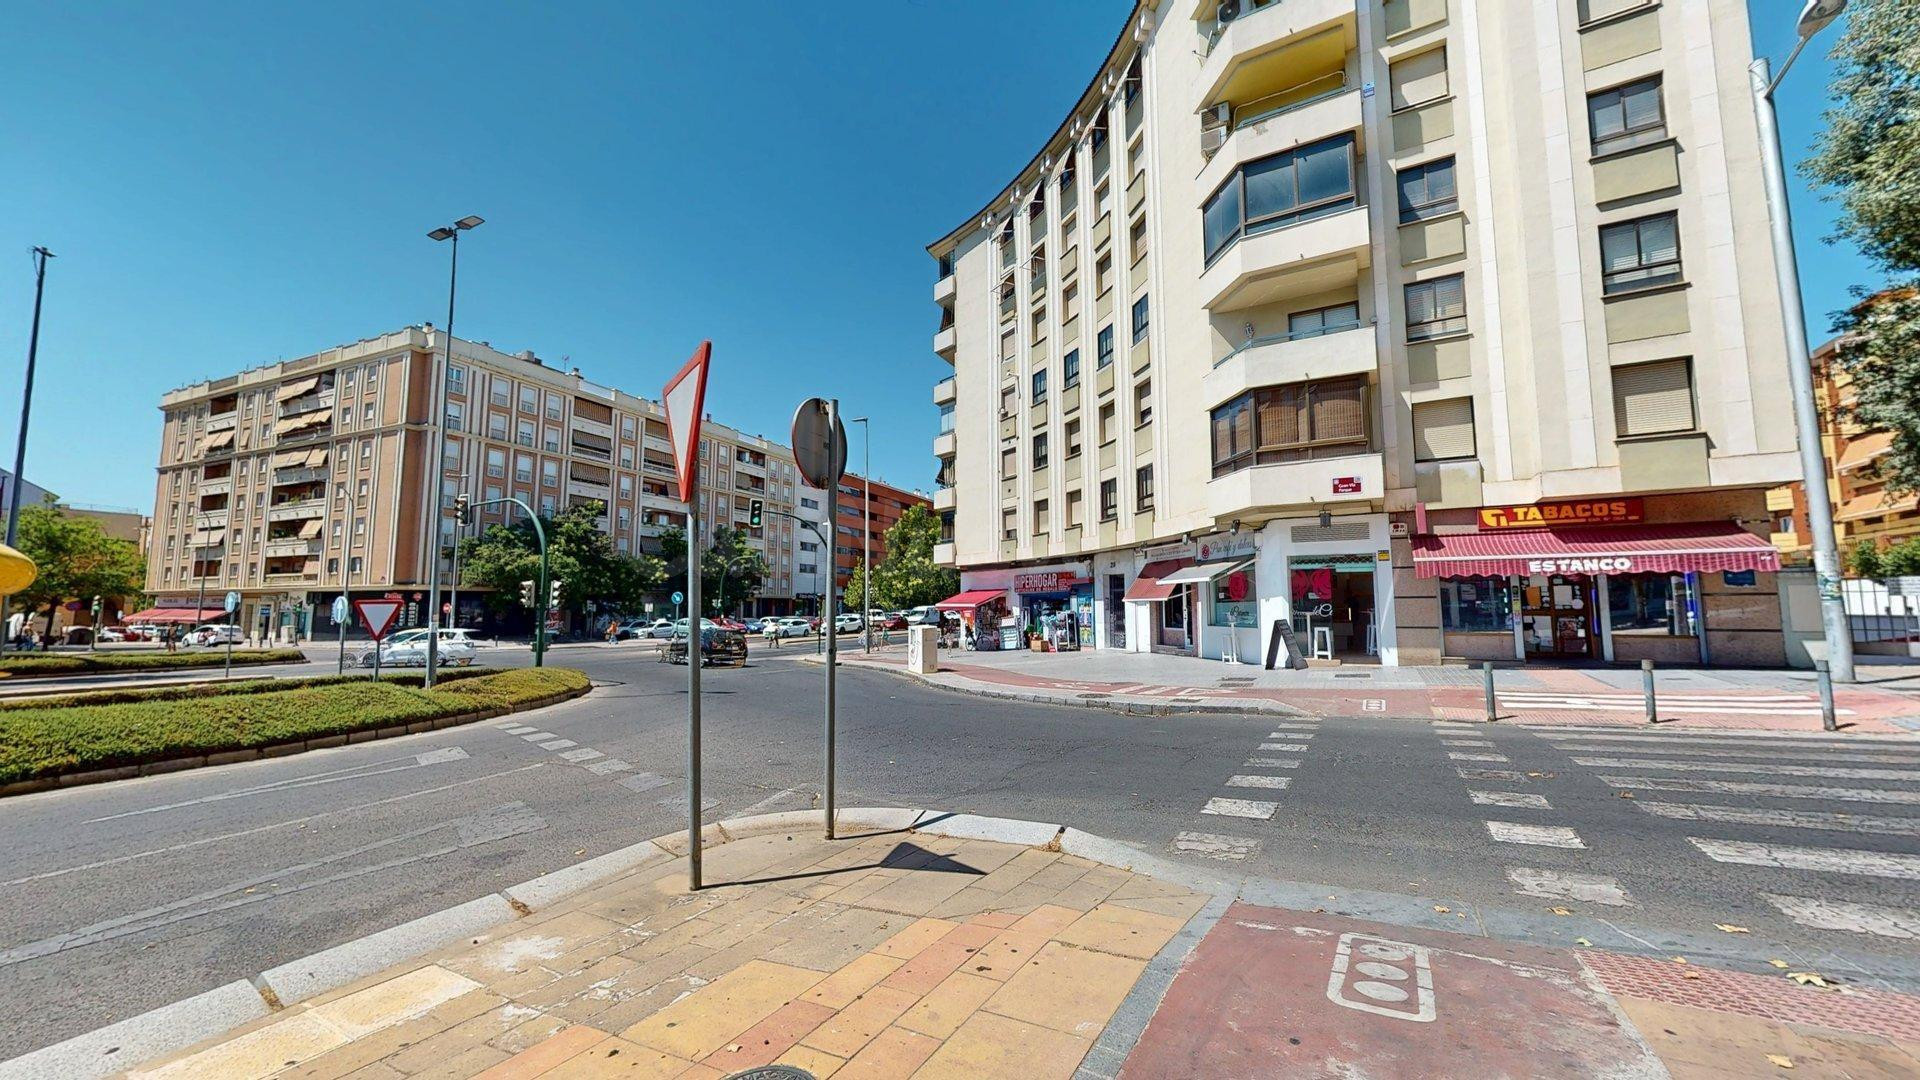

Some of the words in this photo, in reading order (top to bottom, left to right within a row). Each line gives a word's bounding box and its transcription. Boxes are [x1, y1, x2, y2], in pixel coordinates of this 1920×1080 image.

[1512, 501, 1628, 522] TABACOS
[1529, 557, 1633, 573] ESTANCO
[1015, 573, 1058, 588] HIPERHOGAR
